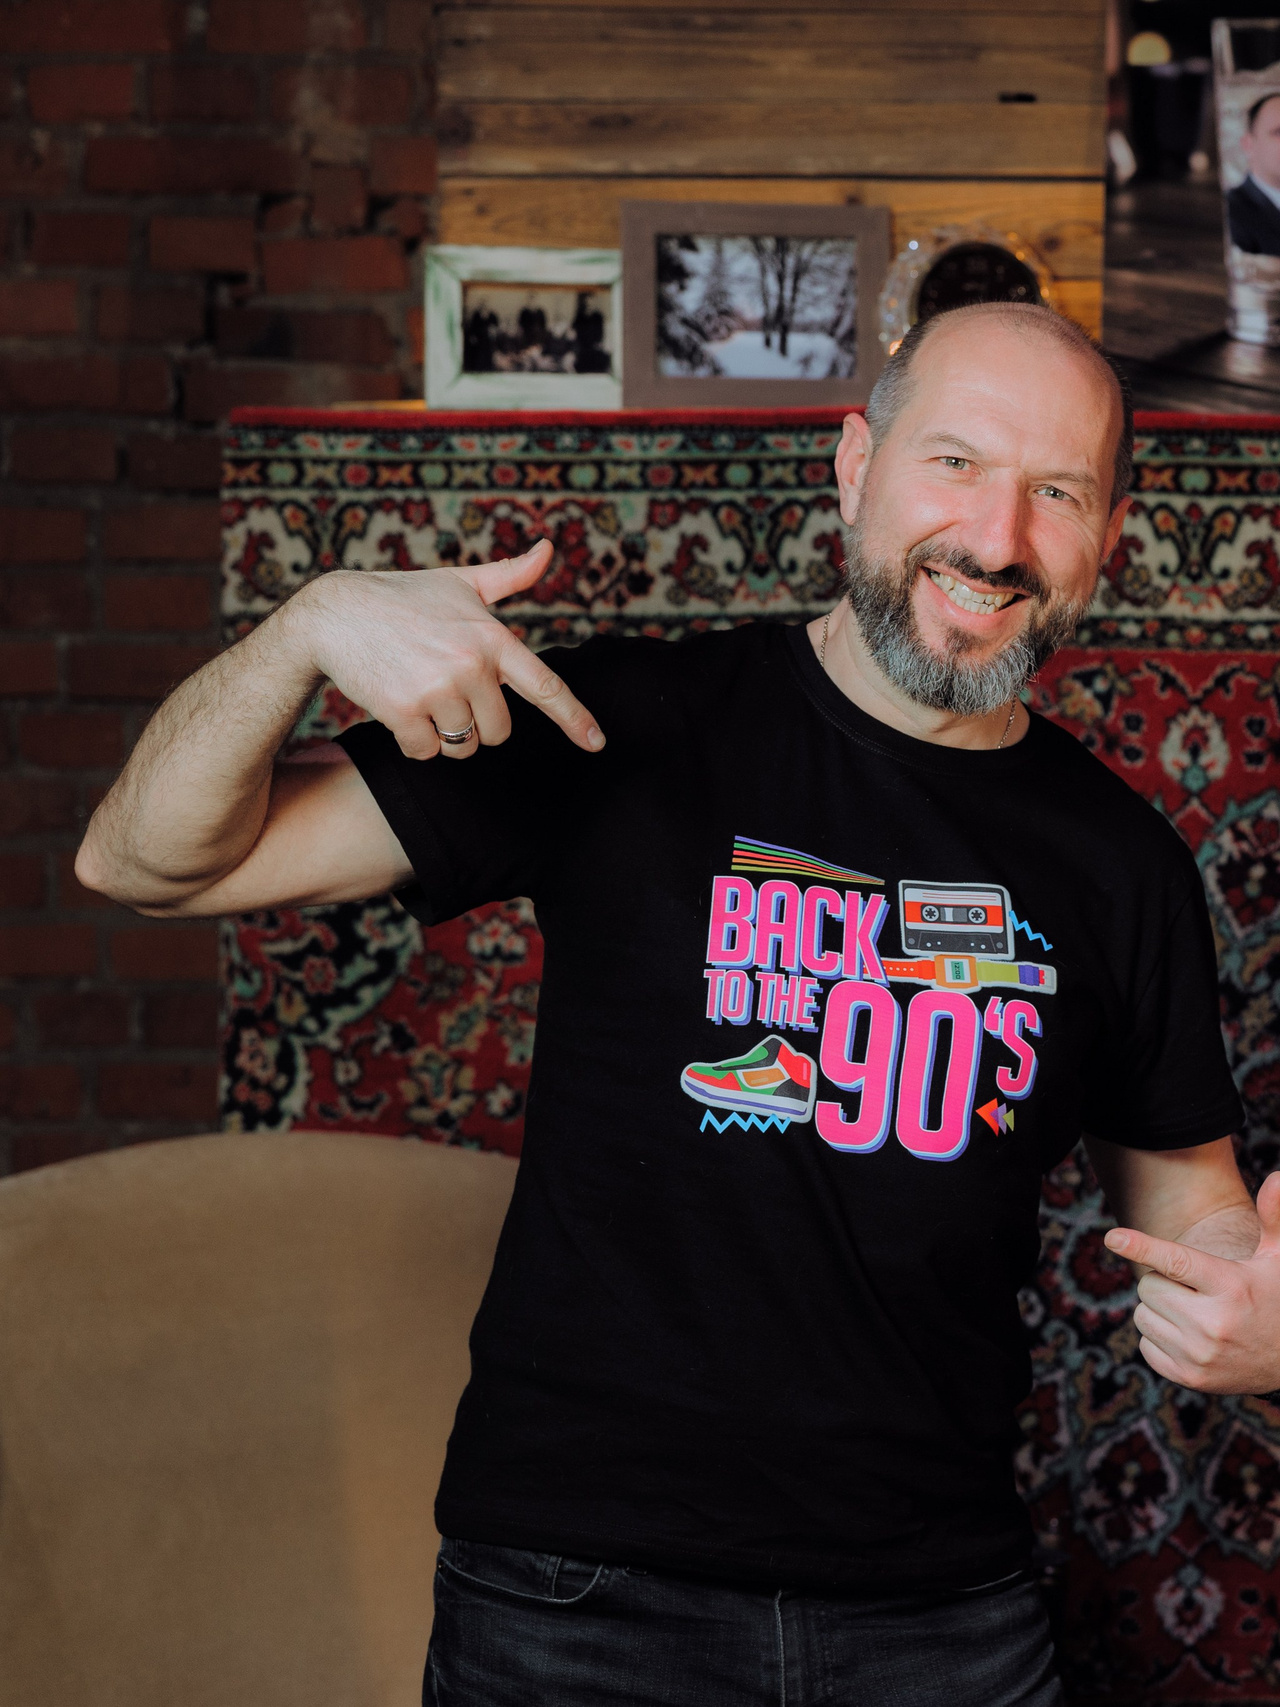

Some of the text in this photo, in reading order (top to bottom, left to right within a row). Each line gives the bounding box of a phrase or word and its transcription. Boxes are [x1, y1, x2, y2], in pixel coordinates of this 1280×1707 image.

[707, 876, 889, 987] BACK
[704, 969, 754, 1026] TO
[757, 971, 823, 1033] THE
